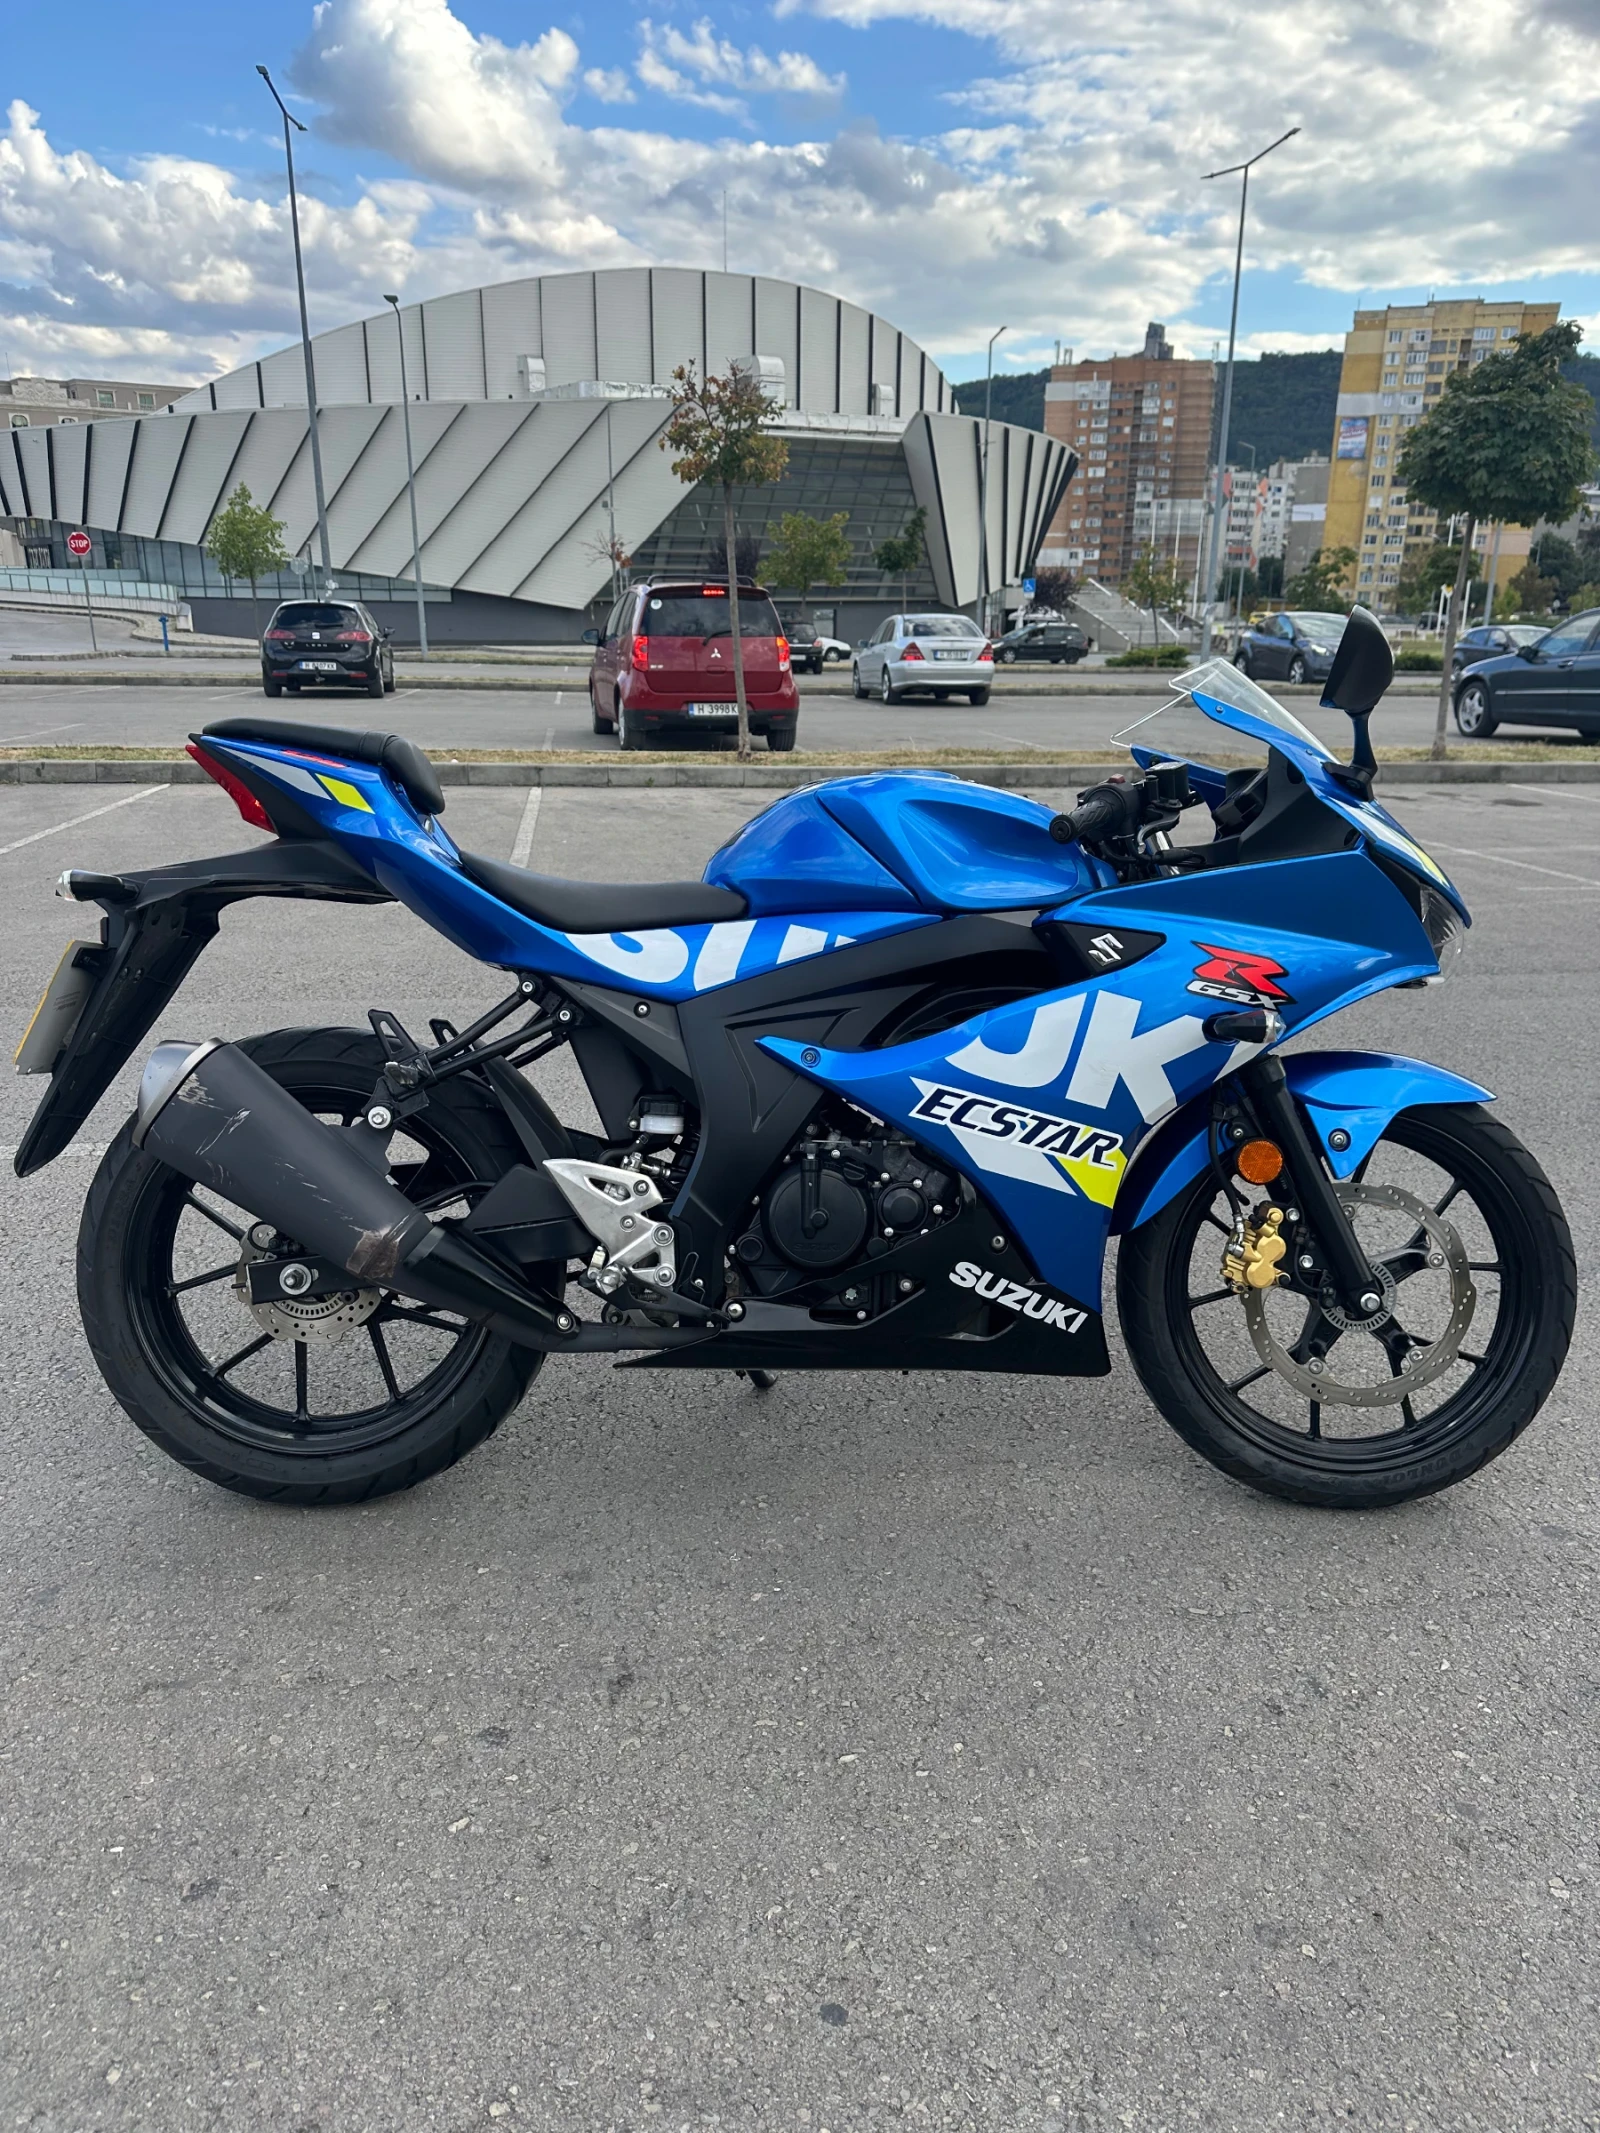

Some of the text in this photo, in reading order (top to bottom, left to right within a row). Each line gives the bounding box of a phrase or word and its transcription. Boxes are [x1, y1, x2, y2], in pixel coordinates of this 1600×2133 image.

[70, 539, 88, 548] STOP
[708, 704, 738, 714] 3998K
[1186, 979, 1288, 1011] GSX
[914, 1086, 1121, 1169] ECSTAR
[948, 1261, 1089, 1334] SUZUKI
